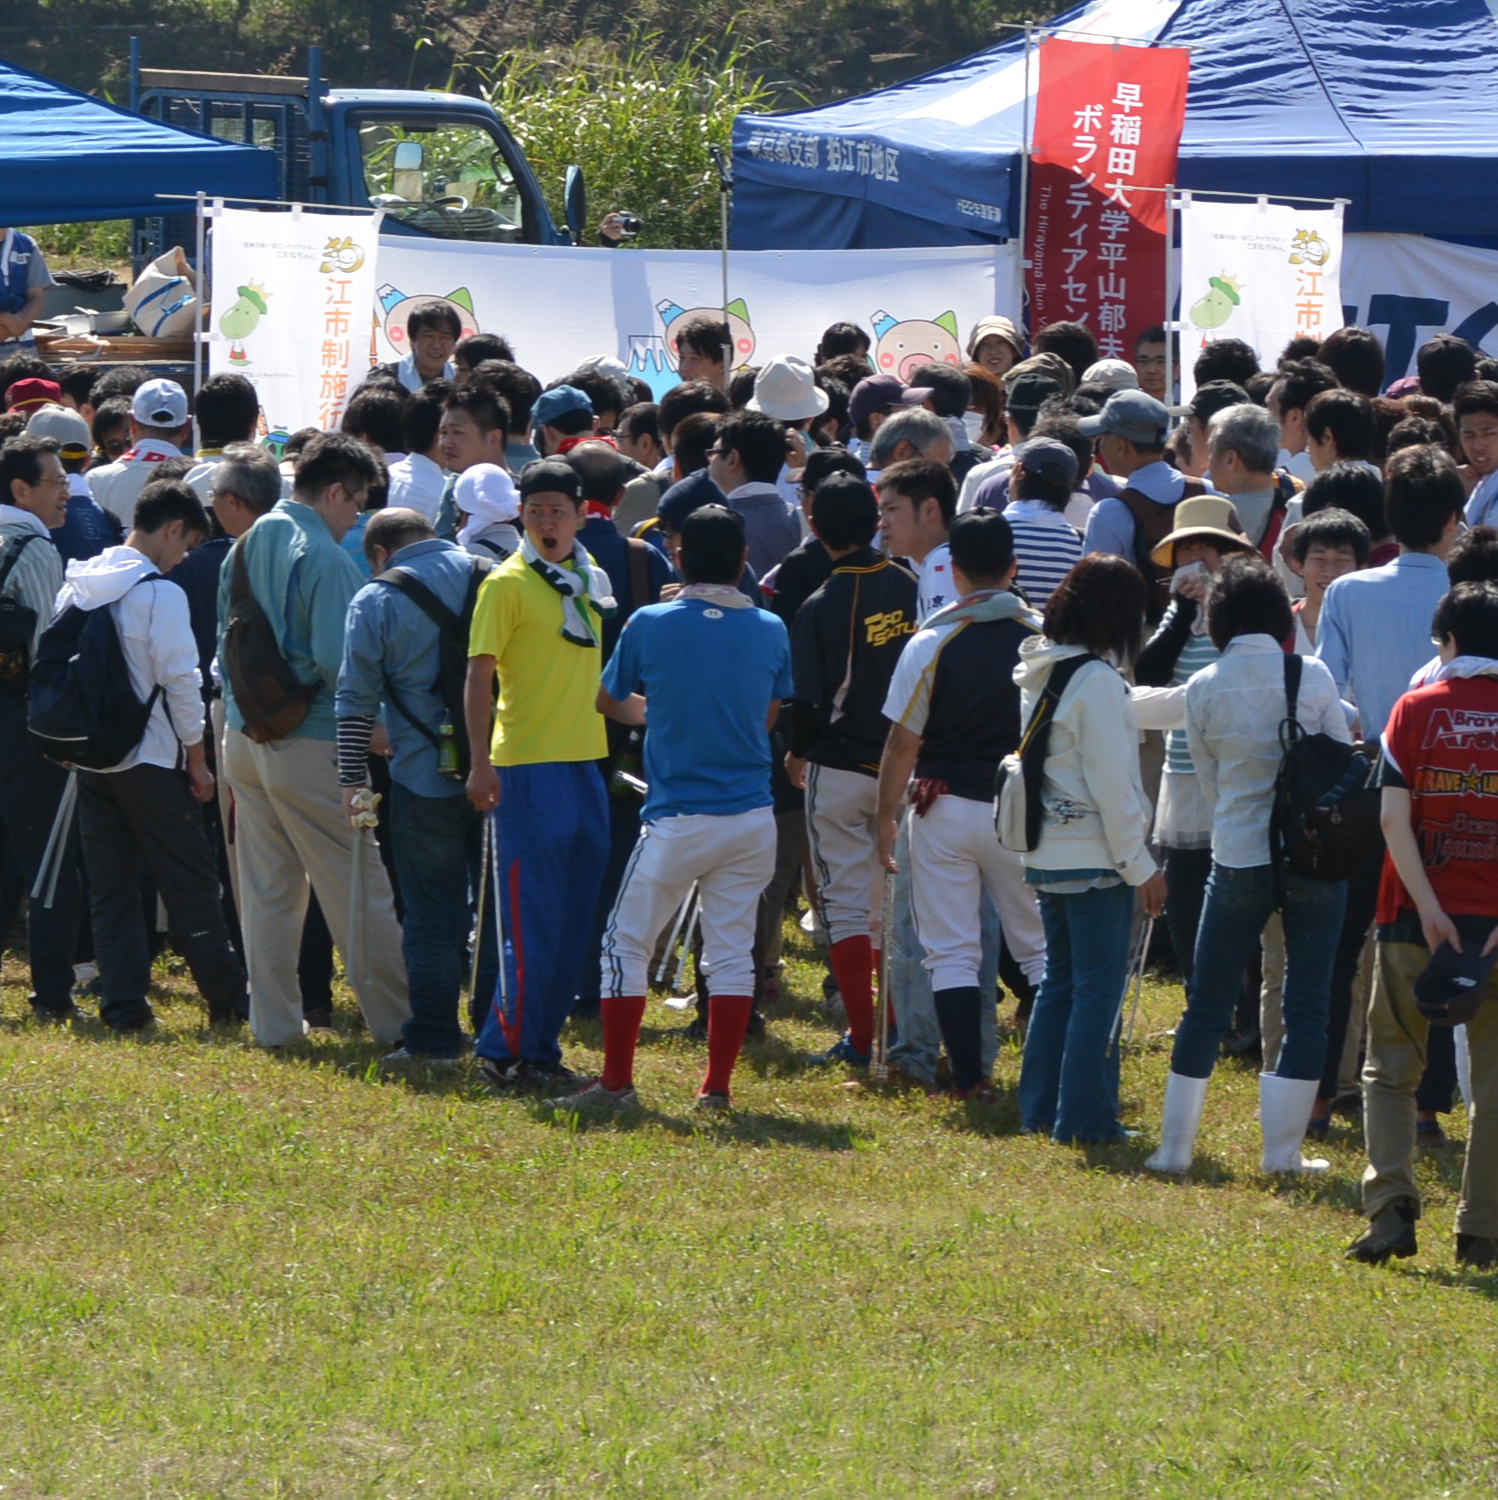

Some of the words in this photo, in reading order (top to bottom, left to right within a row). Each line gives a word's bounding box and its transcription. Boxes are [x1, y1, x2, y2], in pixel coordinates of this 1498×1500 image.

[747, 130, 820, 169] 東京都支部
[826, 137, 901, 183] 狛江市地区
[1039, 185, 1052, 210] The
[1097, 82, 1144, 360] 早稲田大学平山郁夫
[1033, 215, 1050, 278] Hirayama
[1034, 283, 1047, 310] Ikuo
[1288, 228, 1330, 342] 狛江市
[1415, 768, 1462, 794] BRAVE
